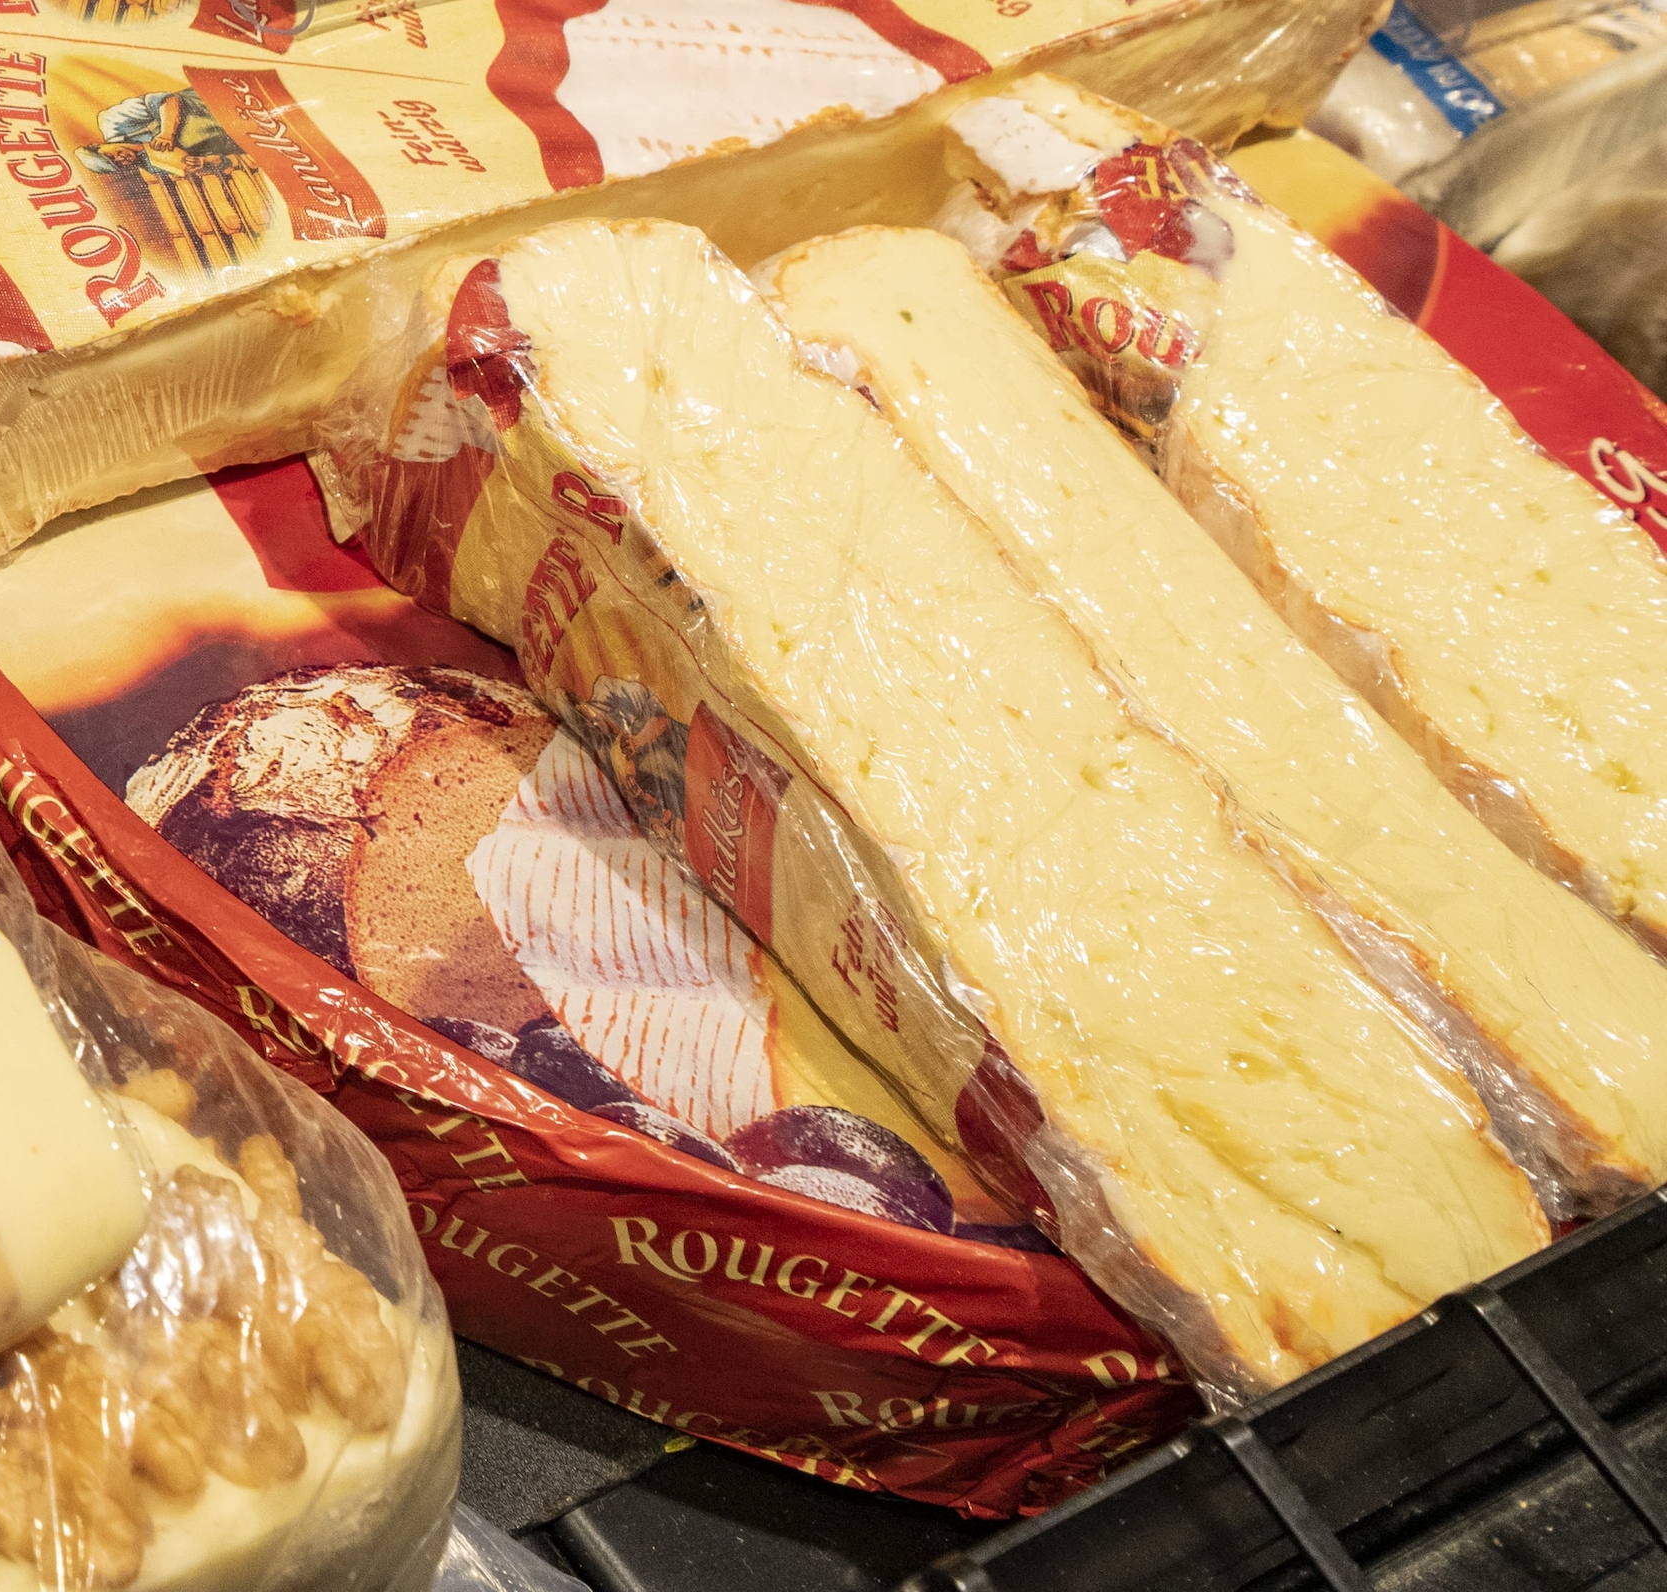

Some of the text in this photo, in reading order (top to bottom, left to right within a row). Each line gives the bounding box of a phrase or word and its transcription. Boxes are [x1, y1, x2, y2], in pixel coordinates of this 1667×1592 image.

[220, 76, 367, 243] Landkäse
[378, 109, 447, 168] Fein-
[392, 99, 488, 174] würzig
[608, 1215, 999, 1367] ROUGETTE
